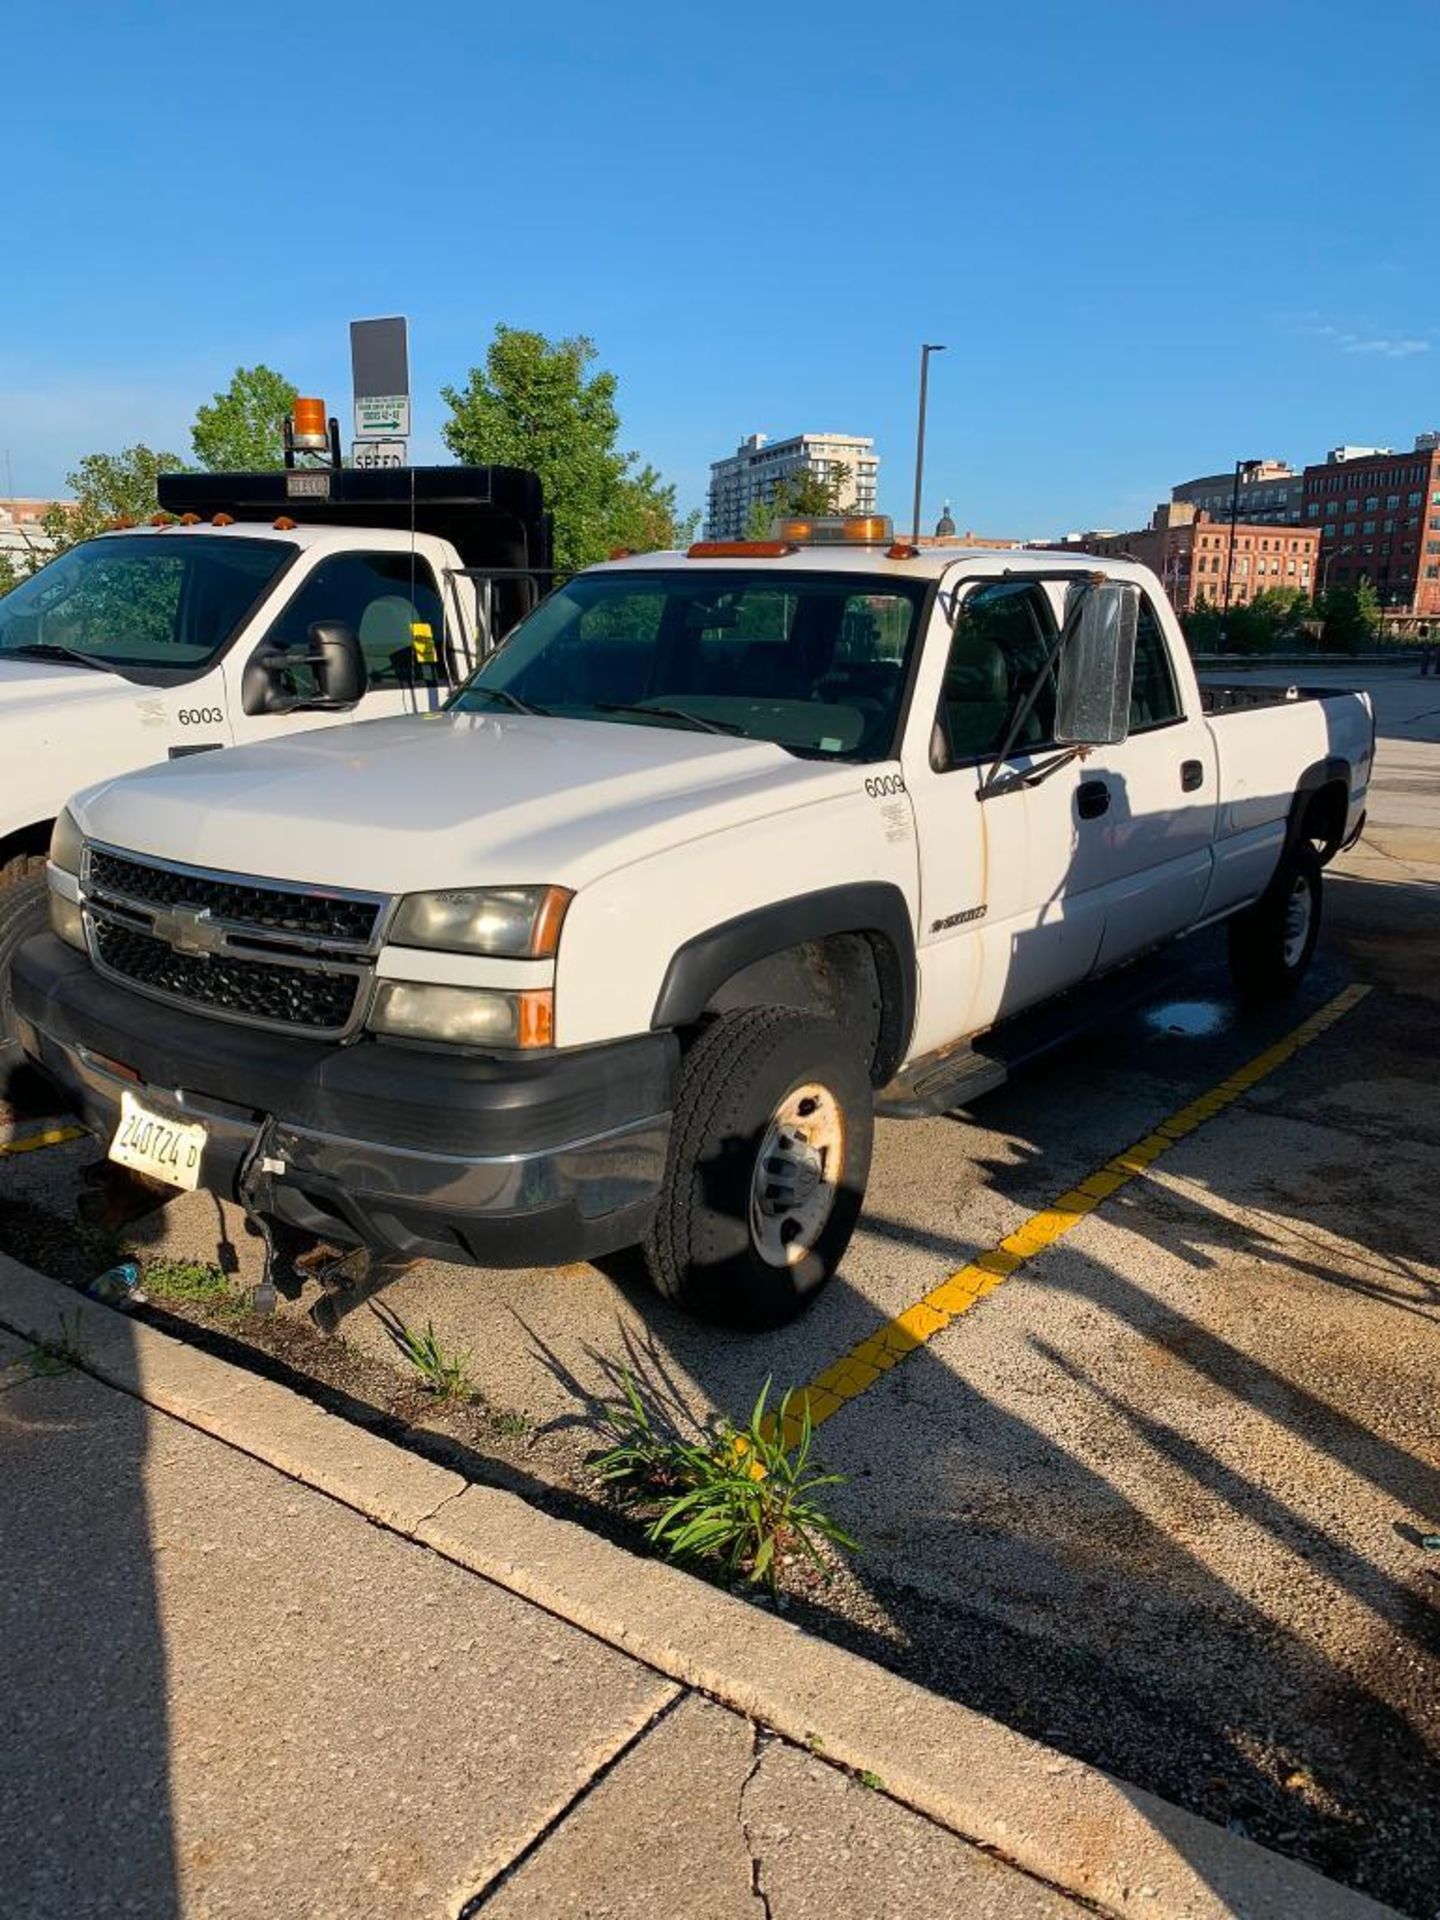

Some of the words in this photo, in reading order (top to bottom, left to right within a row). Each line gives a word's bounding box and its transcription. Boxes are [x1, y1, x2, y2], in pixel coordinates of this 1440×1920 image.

[355, 454, 402, 469] SPEED
[179, 707, 223, 725] 6003
[865, 774, 906, 798] 6009
[120, 1115, 182, 1165] 240724
